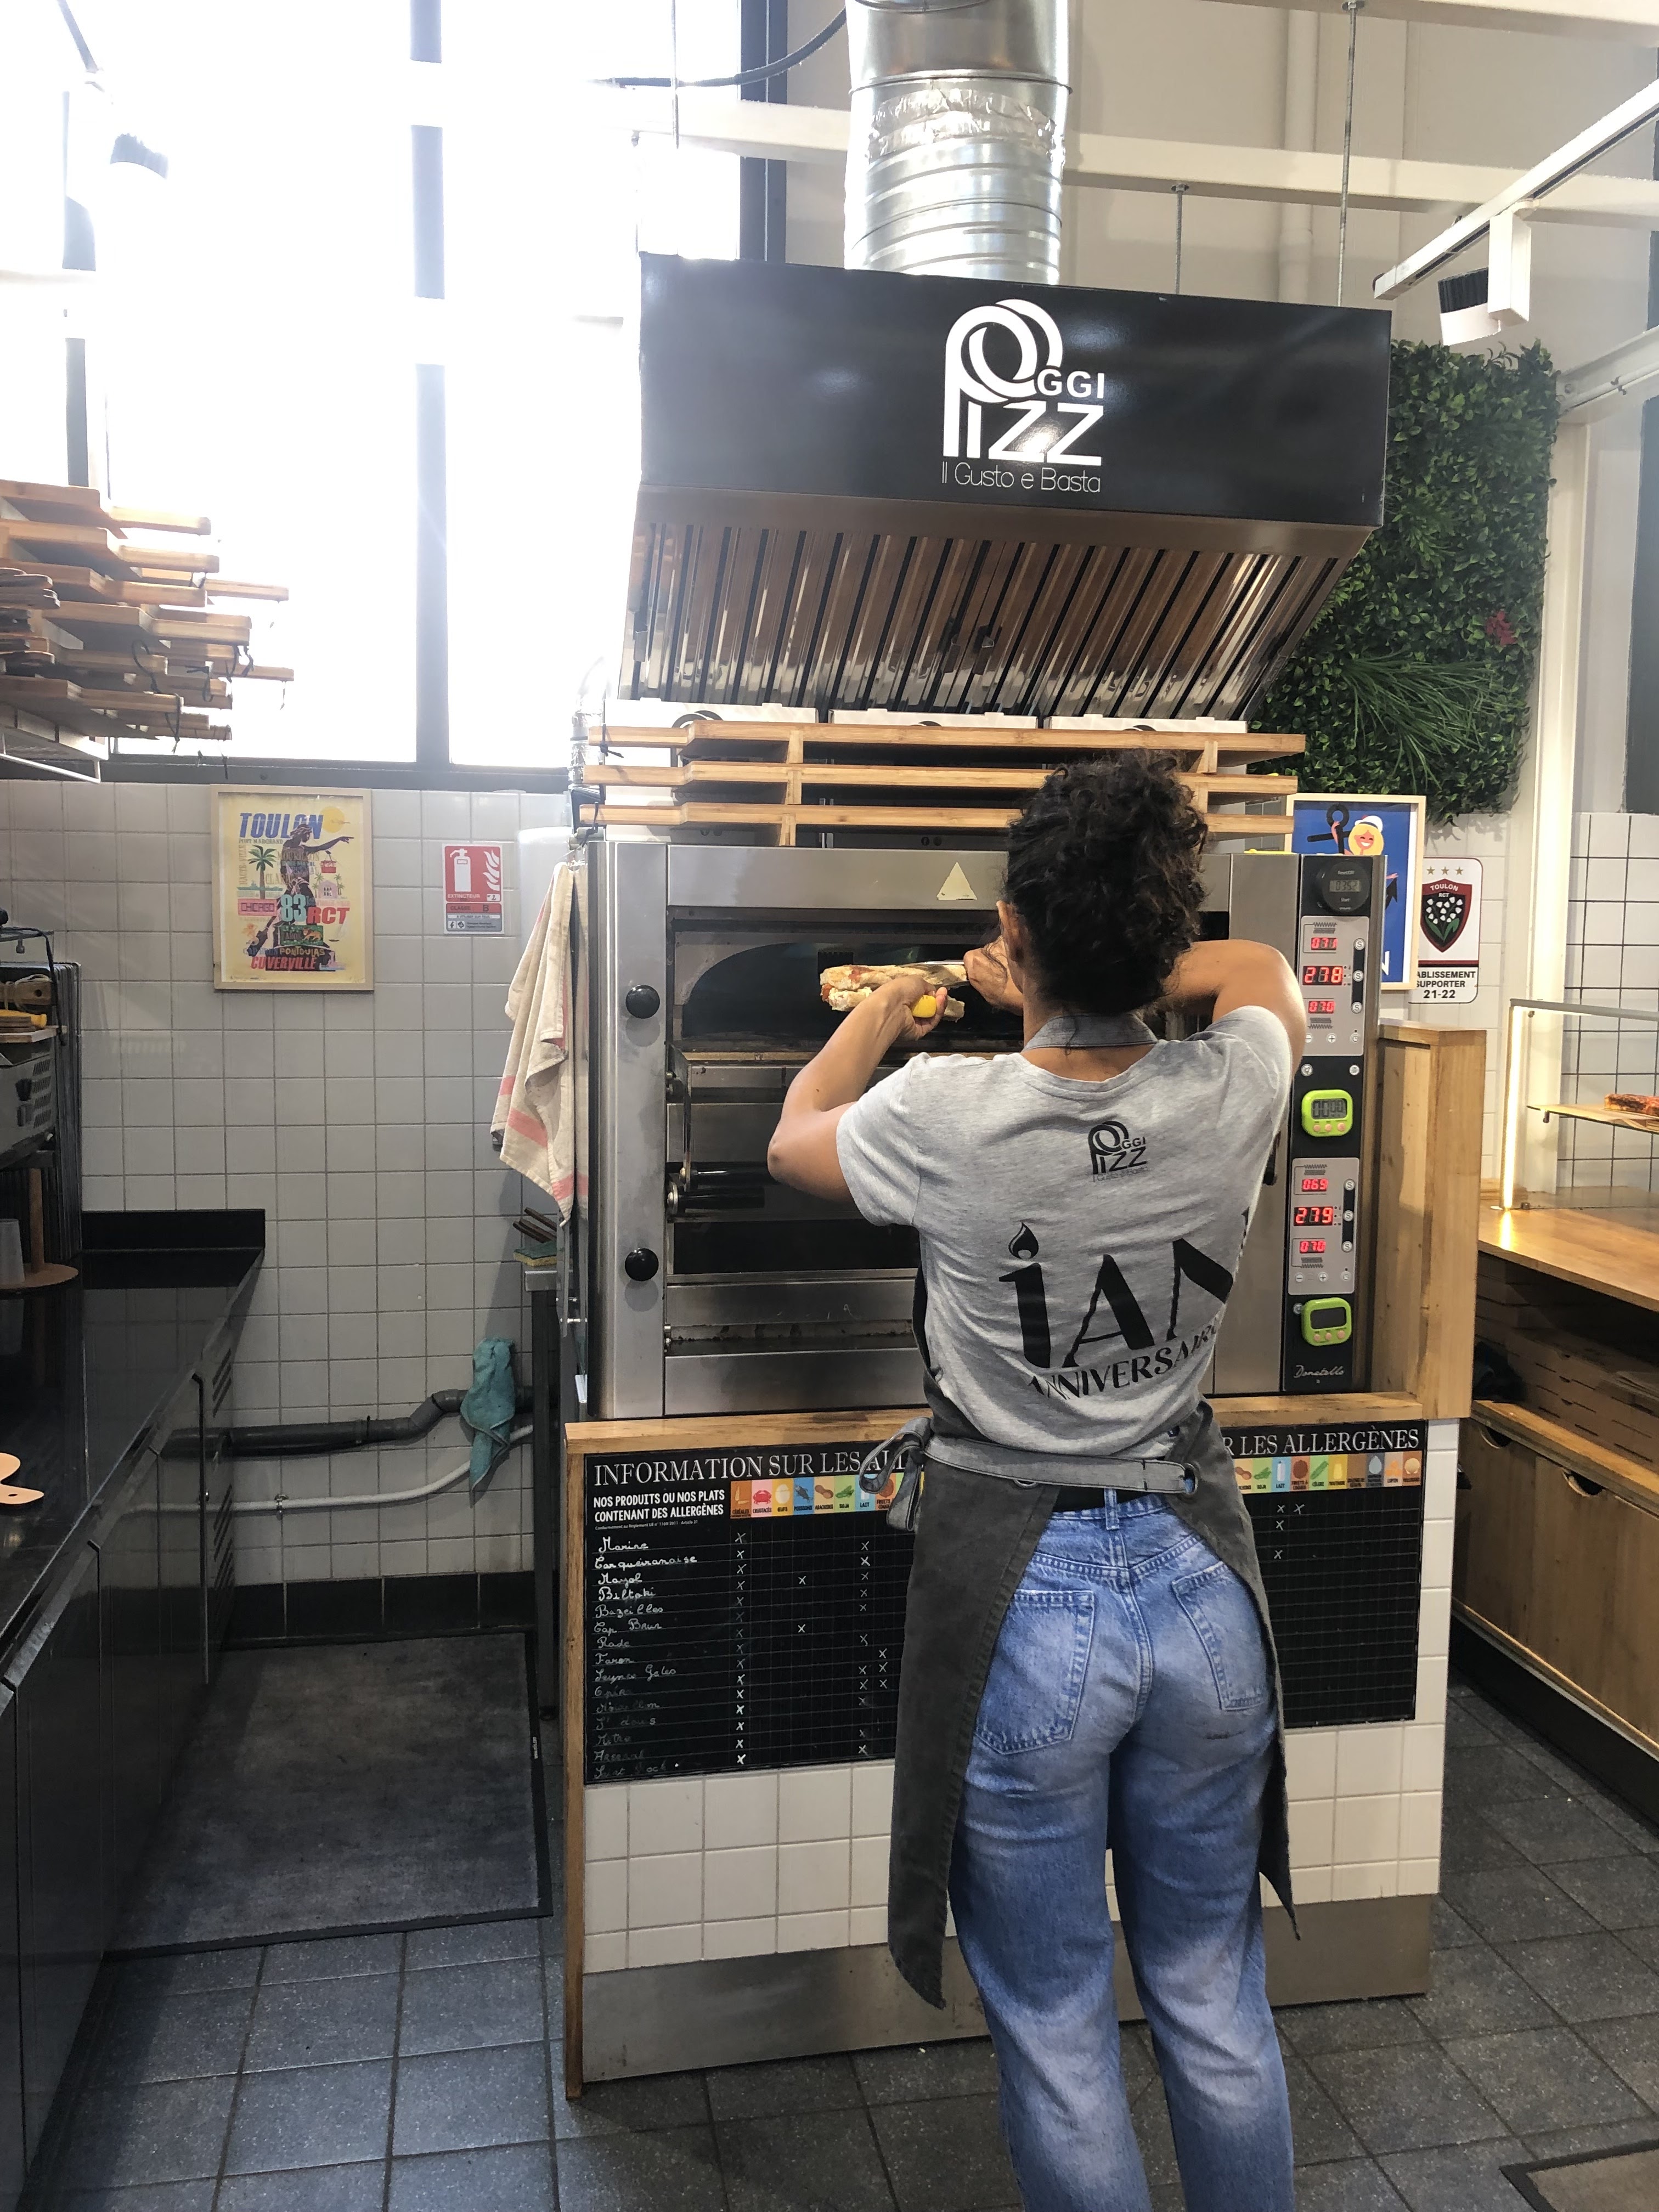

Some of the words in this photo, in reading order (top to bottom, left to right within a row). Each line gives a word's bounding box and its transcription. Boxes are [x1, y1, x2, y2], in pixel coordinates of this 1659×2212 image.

[941, 461, 948, 484] Il
[955, 462, 1014, 488] Gusto
[1020, 472, 1034, 489] e
[1041, 467, 1101, 493] Basta
[240, 812, 324, 839] TOULON
[1429, 883, 1459, 891] TOULON
[280, 894, 307, 922] 83
[306, 906, 351, 924] RCT
[251, 956, 318, 970] CUVERVILLE
[1304, 967, 1344, 984] 278
[1416, 980, 1466, 988] SUPPORTER
[1423, 989, 1456, 999] 21-22
[1308, 1001, 1336, 1013] 070
[1302, 1178, 1329, 1190] 069
[1295, 1207, 1333, 1224] 279
[1300, 1240, 1327, 1253] 070
[1239, 1434, 1278, 1455] LES
[1282, 1425, 1420, 1454] ALLERGÈNES
[594, 1457, 764, 1486] INFORMATION
[769, 1454, 815, 1476] SUR
[819, 1451, 861, 1474] LES
[593, 1496, 613, 1508] NOS
[615, 1493, 661, 1507] PRODUITS
[662, 1492, 675, 1503] OU
[677, 1491, 696, 1503] NOS
[698, 1489, 725, 1502] PLATS
[594, 1508, 650, 1522] CONTENANT
[652, 1507, 668, 1519] DES
[670, 1503, 724, 1518] ALLERGÈNES
[598, 1536, 649, 1553] Marine
[597, 1572, 643, 1589] Mayol
